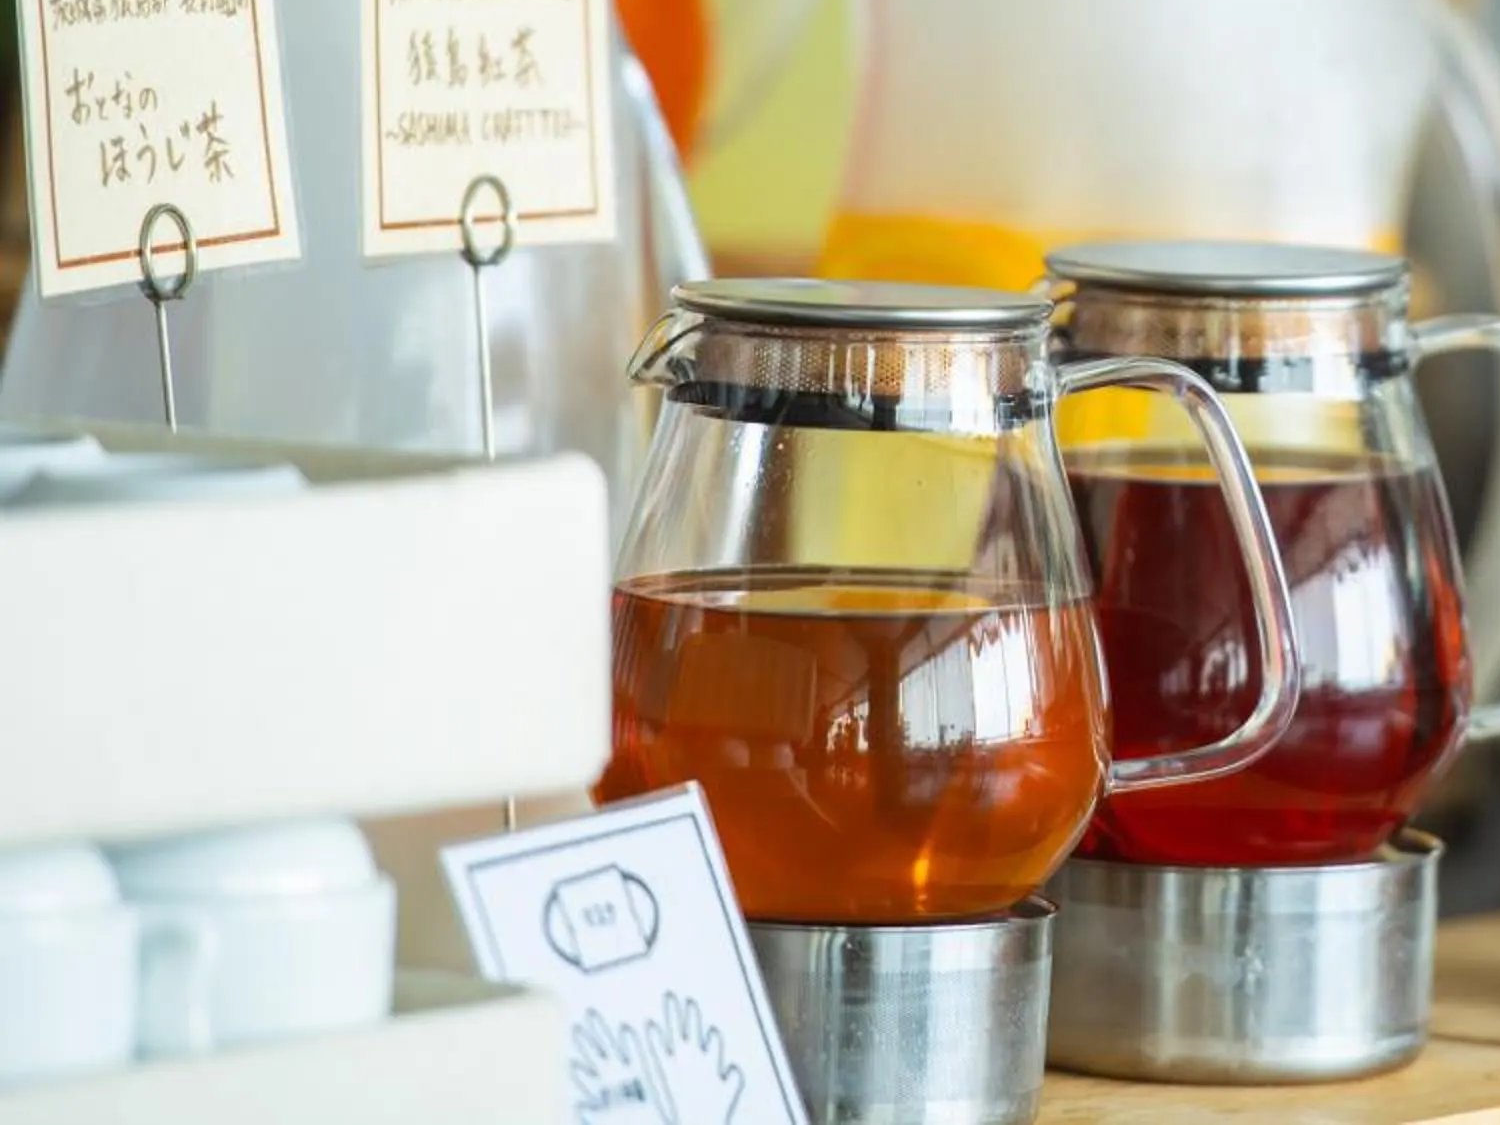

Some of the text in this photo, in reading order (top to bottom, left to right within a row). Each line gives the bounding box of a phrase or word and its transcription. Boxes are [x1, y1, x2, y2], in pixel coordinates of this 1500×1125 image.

[64, 67, 159, 126] おとなの
[101, 99, 235, 187] ほうじ茶
